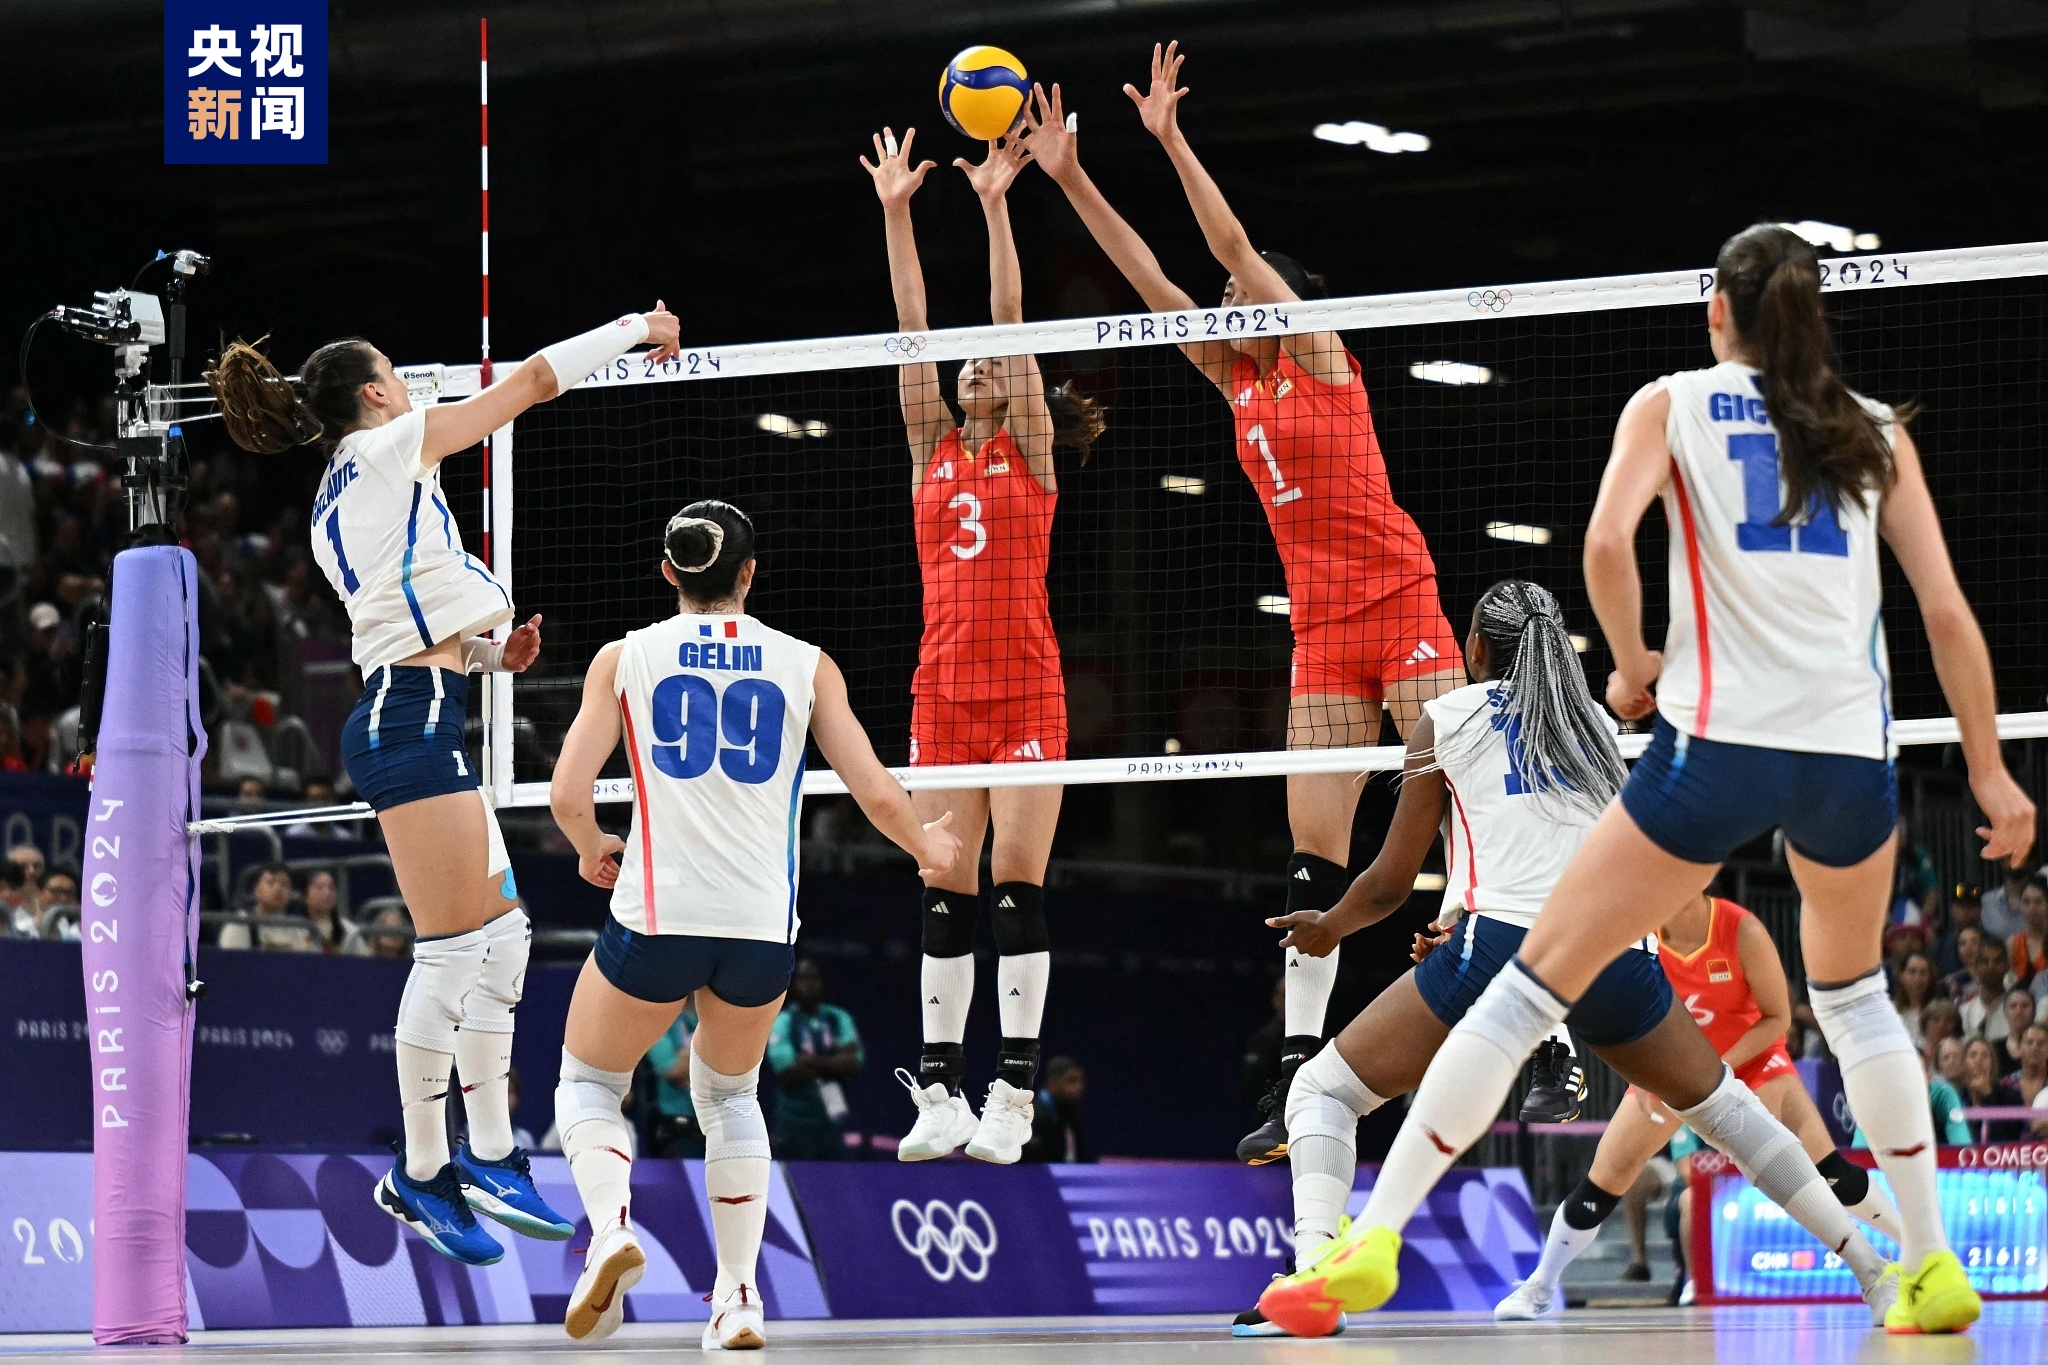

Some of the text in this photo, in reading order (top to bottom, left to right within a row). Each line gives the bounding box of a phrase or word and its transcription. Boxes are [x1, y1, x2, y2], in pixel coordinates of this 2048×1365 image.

[1819, 258, 1909, 287] 2024
[1204, 308, 1290, 335] 2024
[410, 370, 436, 380] Senoh
[643, 350, 720, 378] 2024
[1710, 393, 1767, 424] GIC
[1246, 424, 1303, 506] 1
[948, 492, 986, 559] 3
[326, 505, 361, 596] 1
[678, 642, 762, 671] GELIN
[651, 674, 786, 784] 99
[452, 750, 468, 776] 1
[1192, 760, 1243, 772] 2024
[91, 799, 124, 943] 2024
[1684, 995, 1714, 1025] 6
[1983, 1146, 2048, 1166] OMEG
[1205, 1217, 1295, 1257] 2024
